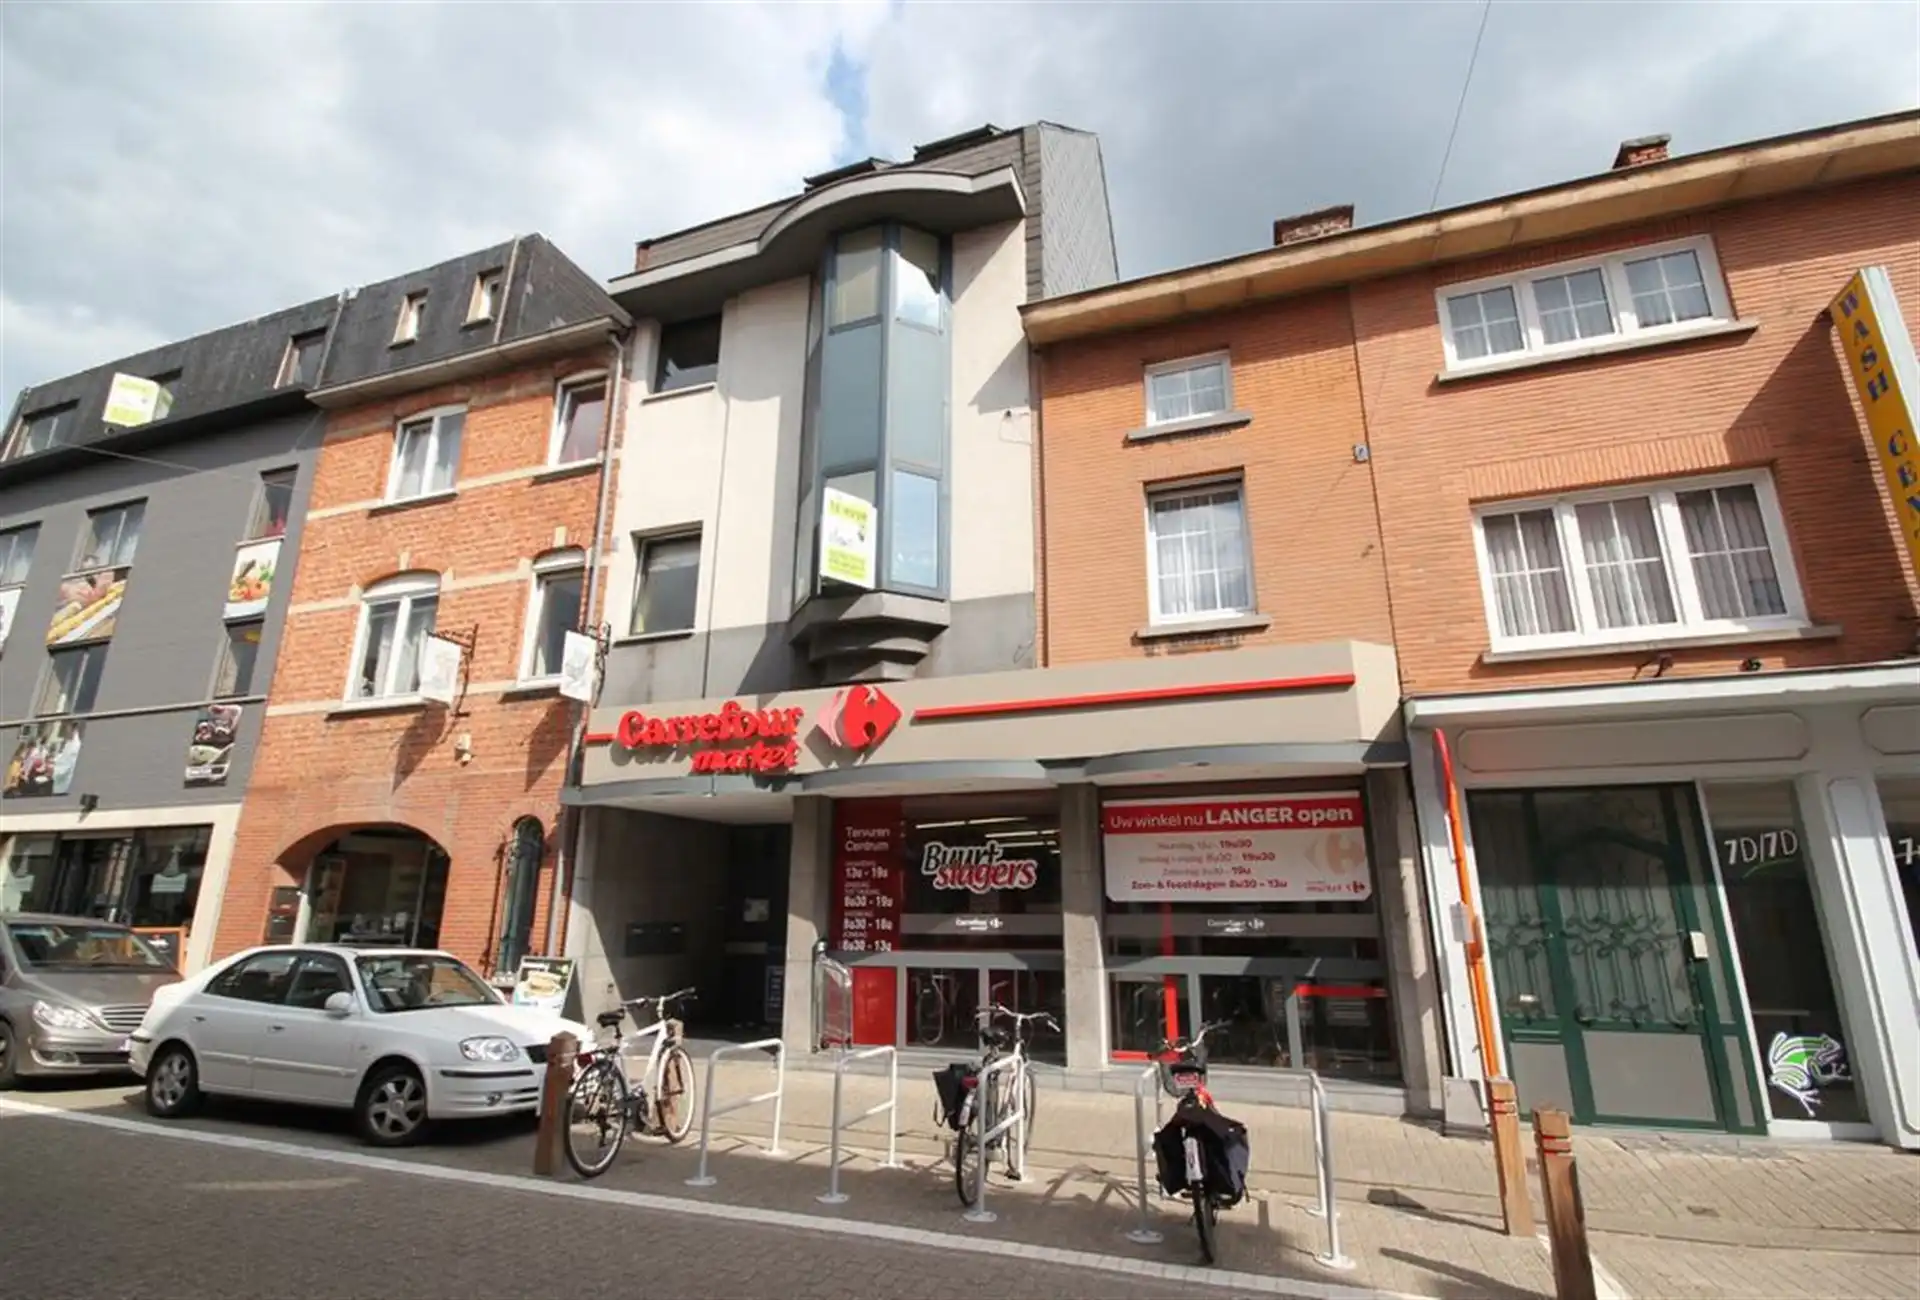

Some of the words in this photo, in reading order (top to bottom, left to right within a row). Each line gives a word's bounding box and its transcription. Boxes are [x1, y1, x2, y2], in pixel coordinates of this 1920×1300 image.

[1838, 290, 1889, 402] WASH
[617, 700, 804, 747] Carrefour
[691, 741, 799, 772] market
[1110, 815, 1133, 829] Uw
[1135, 812, 1181, 828] winkel
[1183, 814, 1204, 827] nu
[1205, 806, 1293, 826] LANGER
[1297, 807, 1353, 827] open
[845, 840, 889, 851] Centrum
[1131, 880, 1155, 889] Zon-
[1229, 878, 1257, 888] 8u30
